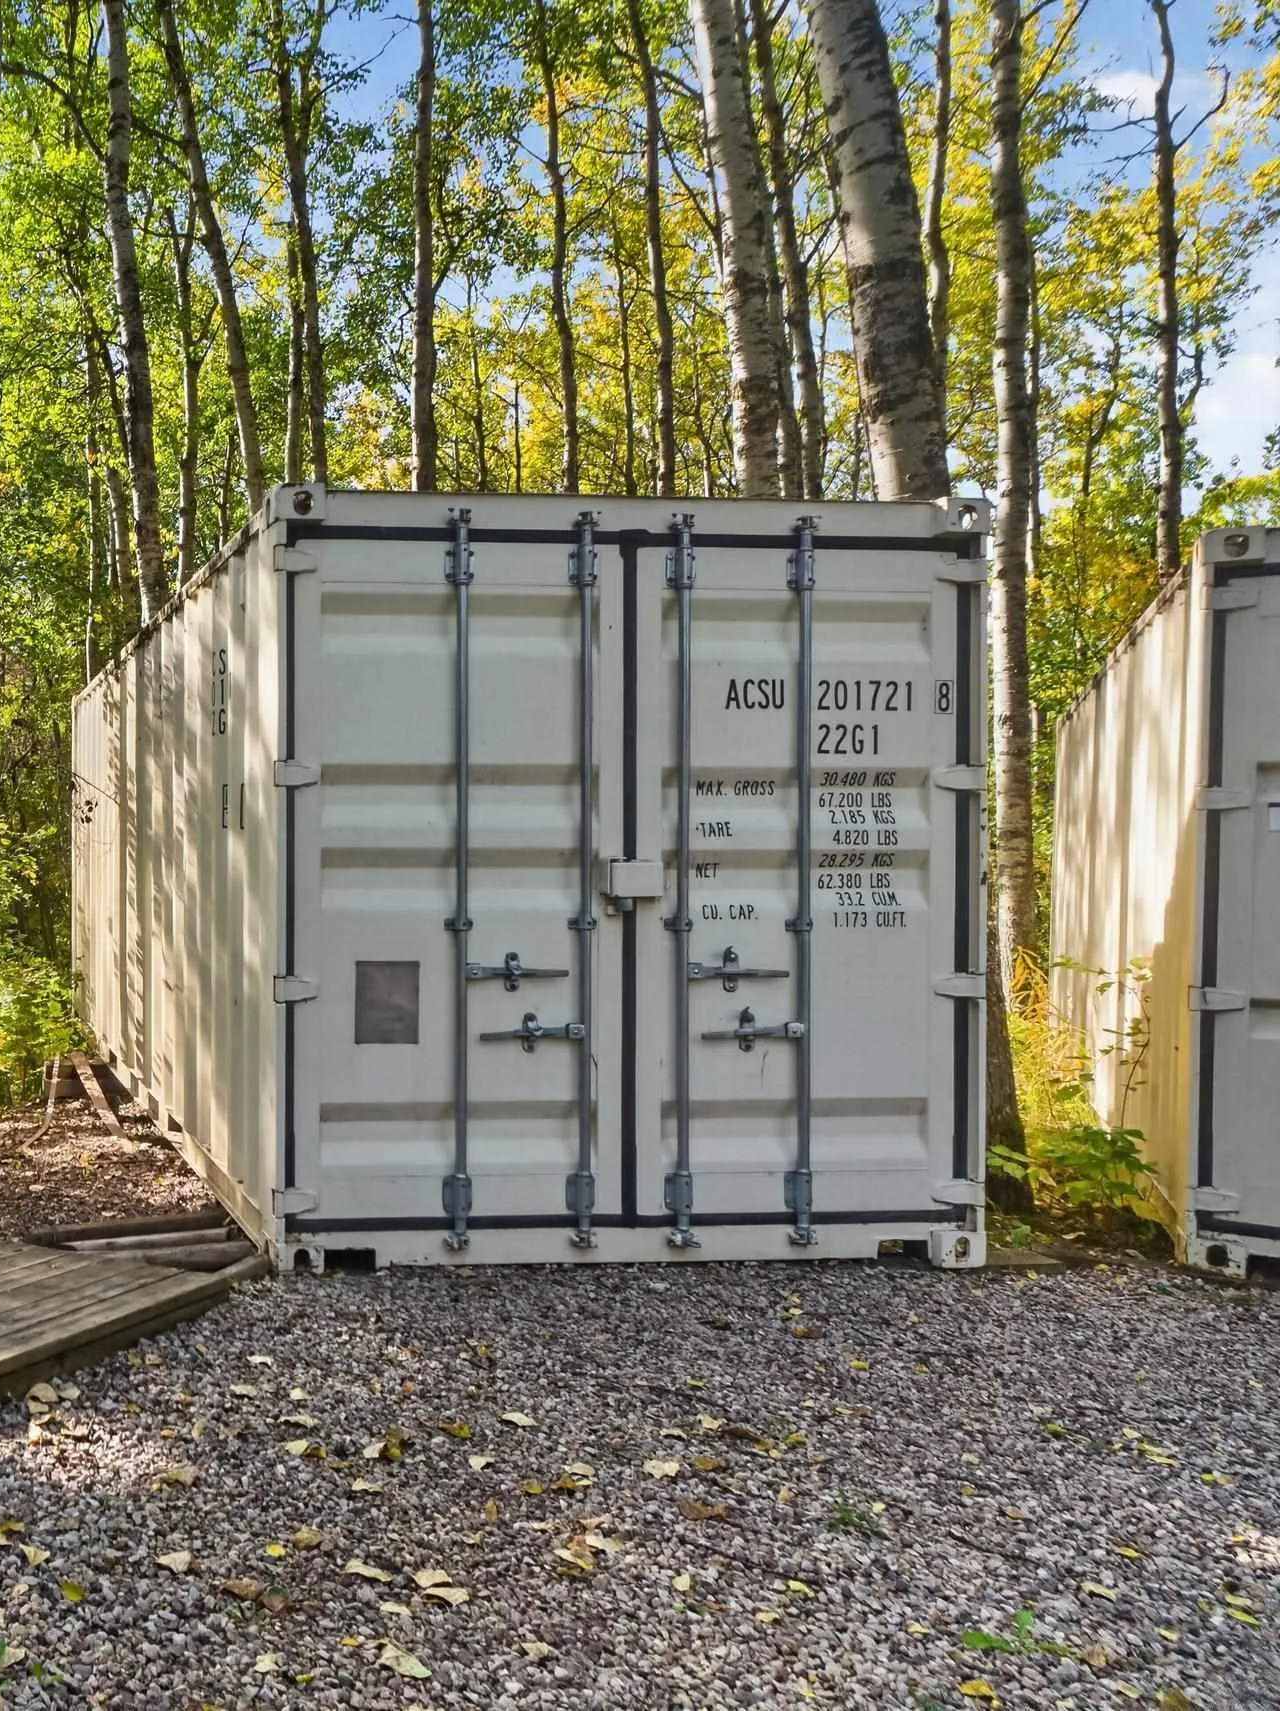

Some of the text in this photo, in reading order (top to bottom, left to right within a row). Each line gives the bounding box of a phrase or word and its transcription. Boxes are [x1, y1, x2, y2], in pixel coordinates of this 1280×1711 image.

[725, 679, 950, 712] ACSU 201721 8
[817, 724, 879, 755] 22G1
[820, 771, 896, 787] 30.480 KGS
[695, 780, 776, 796] MAX. GROSS
[818, 792, 892, 808] 67.200 LBS
[828, 809, 896, 825] 2.185 KGS
[700, 821, 733, 838] TARE
[832, 830, 898, 846] 4.820 LBS
[818, 853, 895, 868] 28.295 KGS
[695, 862, 720, 879] NET
[817, 873, 891, 889] 62.380 LBS
[835, 892, 865, 906] 33.2
[702, 904, 759, 920] CU. CAP.
[833, 912, 868, 928] 1.173
